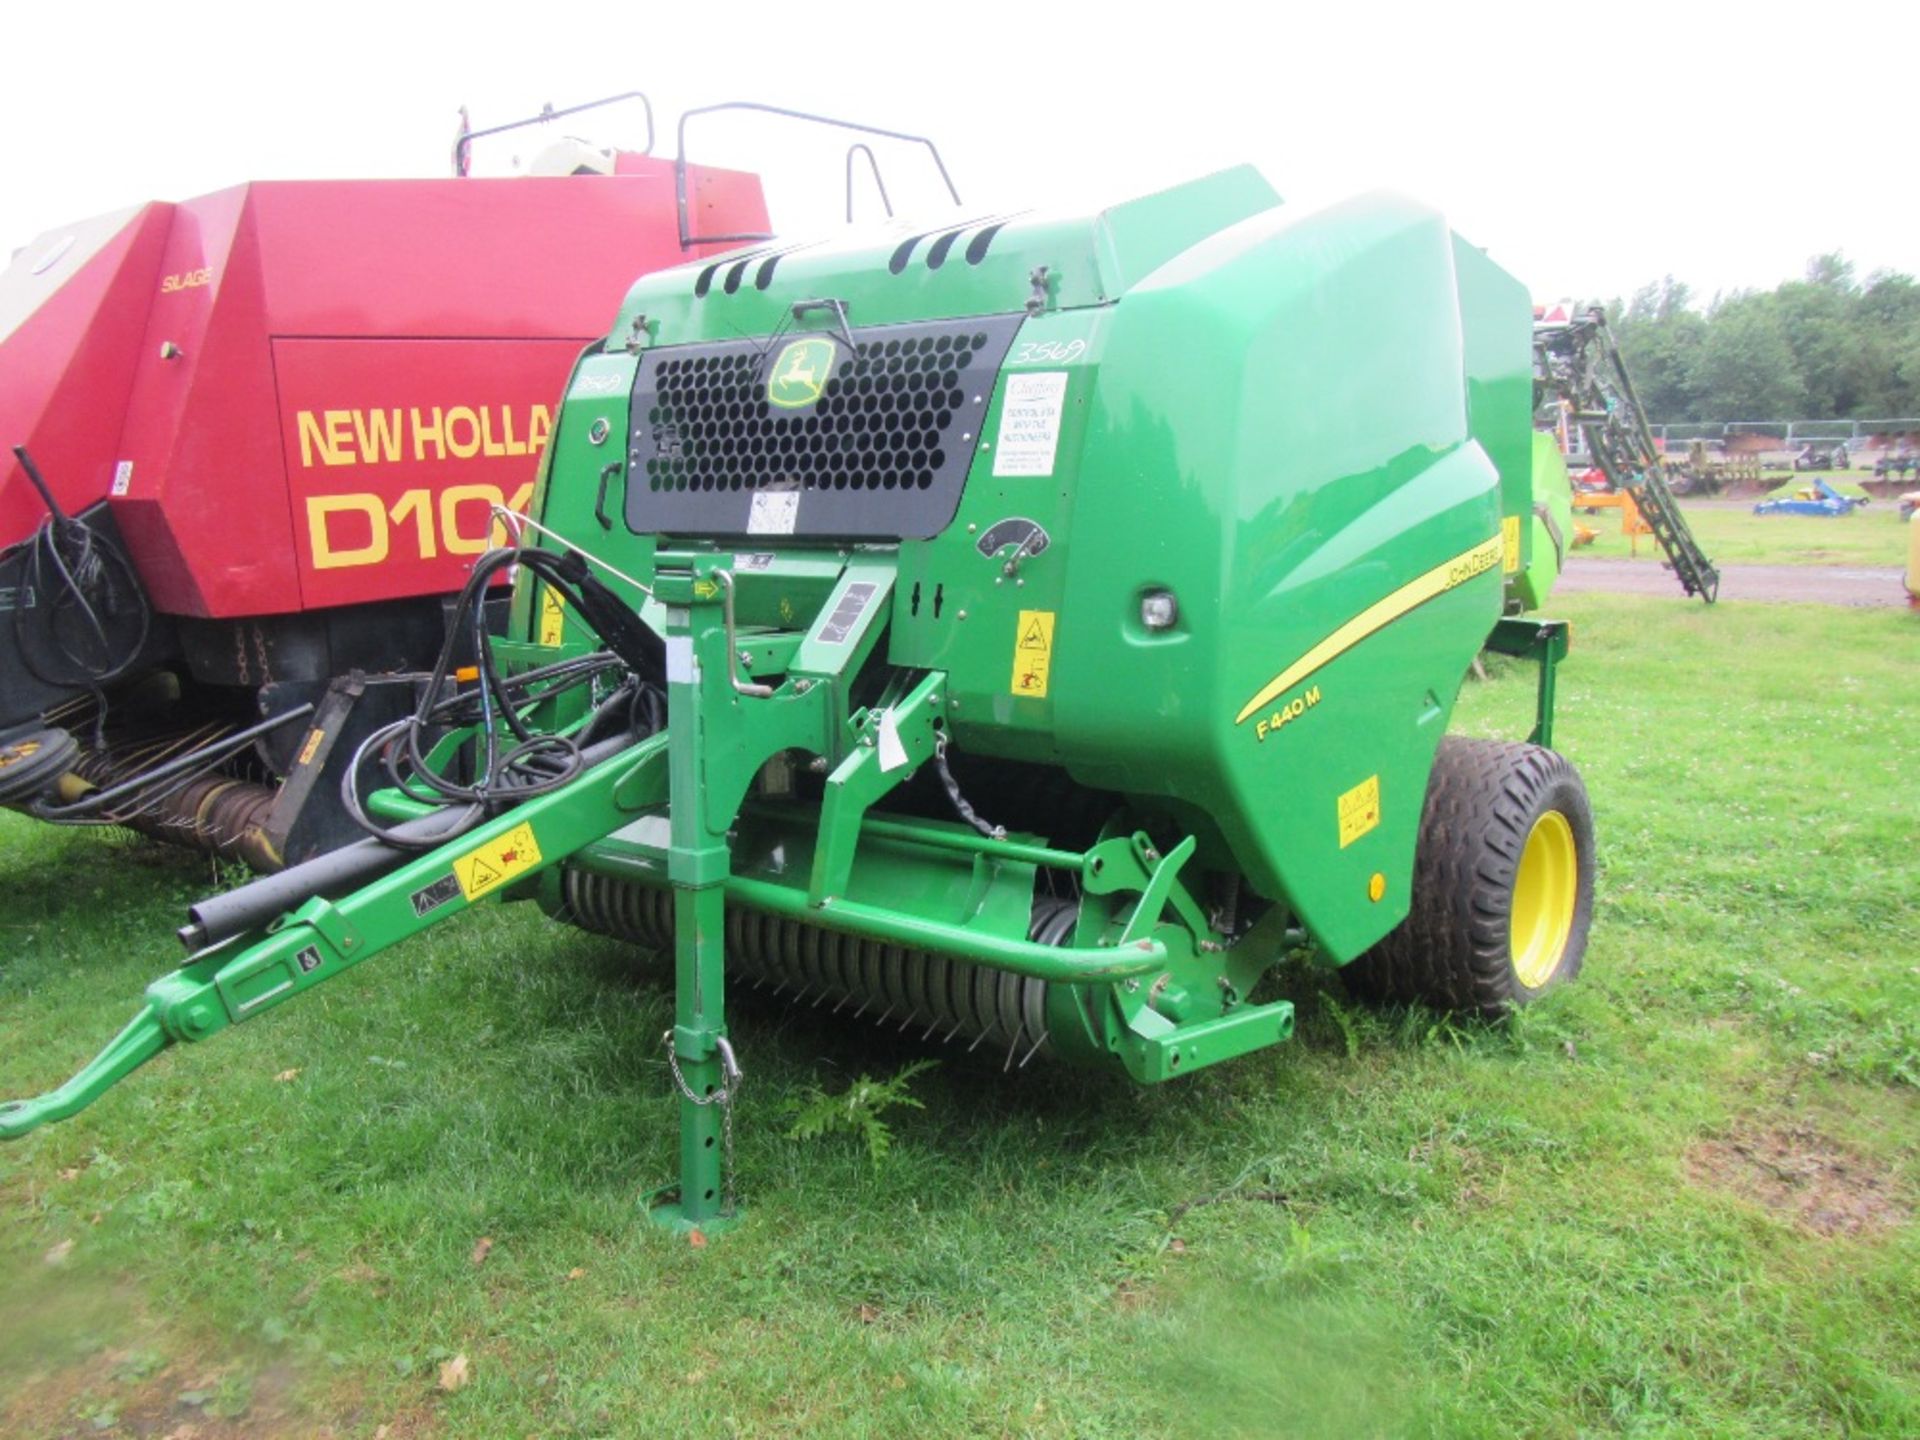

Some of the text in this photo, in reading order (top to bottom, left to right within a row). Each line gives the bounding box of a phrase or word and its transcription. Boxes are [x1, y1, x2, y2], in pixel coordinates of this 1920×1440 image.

[1012, 338, 1086, 365] 3569
[296, 404, 559, 467] NEW HOLLA
[1256, 685, 1321, 741] F 440 M
